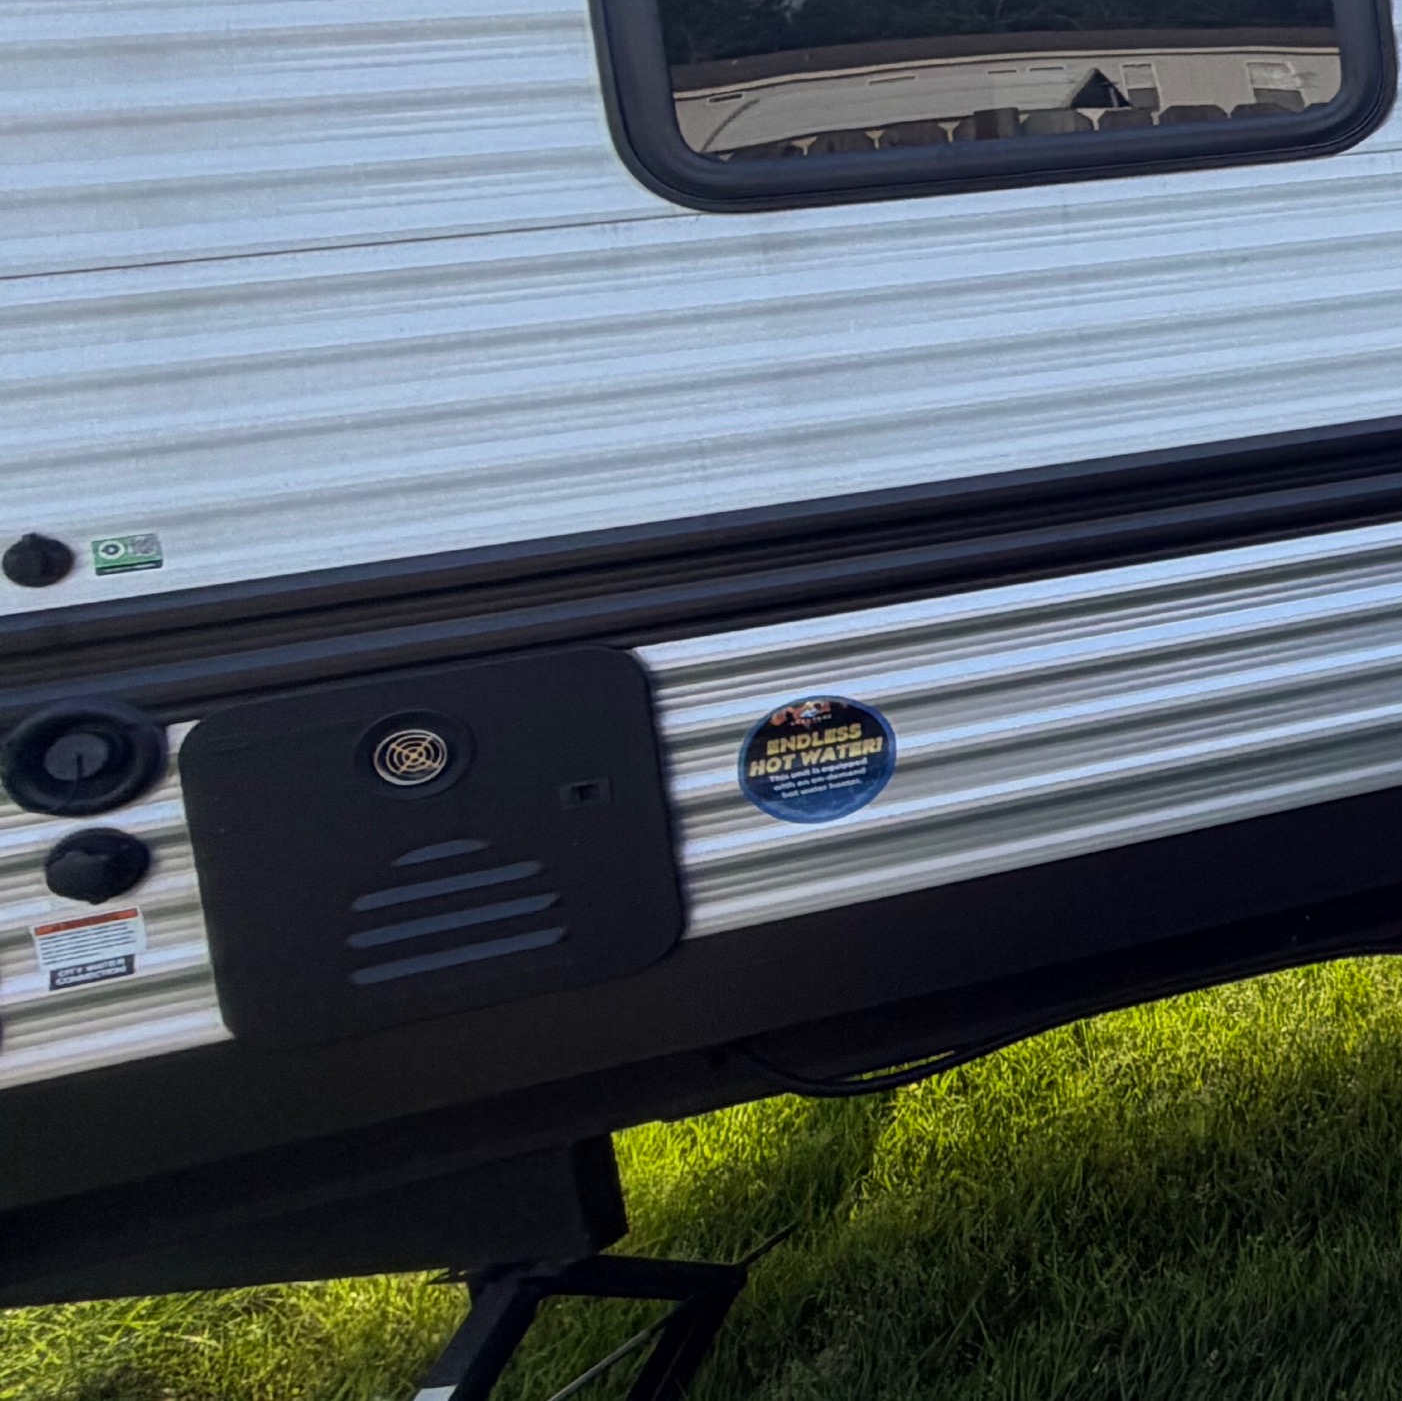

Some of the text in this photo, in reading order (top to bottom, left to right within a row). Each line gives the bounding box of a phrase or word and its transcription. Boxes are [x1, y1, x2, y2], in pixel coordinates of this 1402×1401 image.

[749, 736, 884, 776] HOT WATER!
[766, 723, 862, 755] ENDLESS
